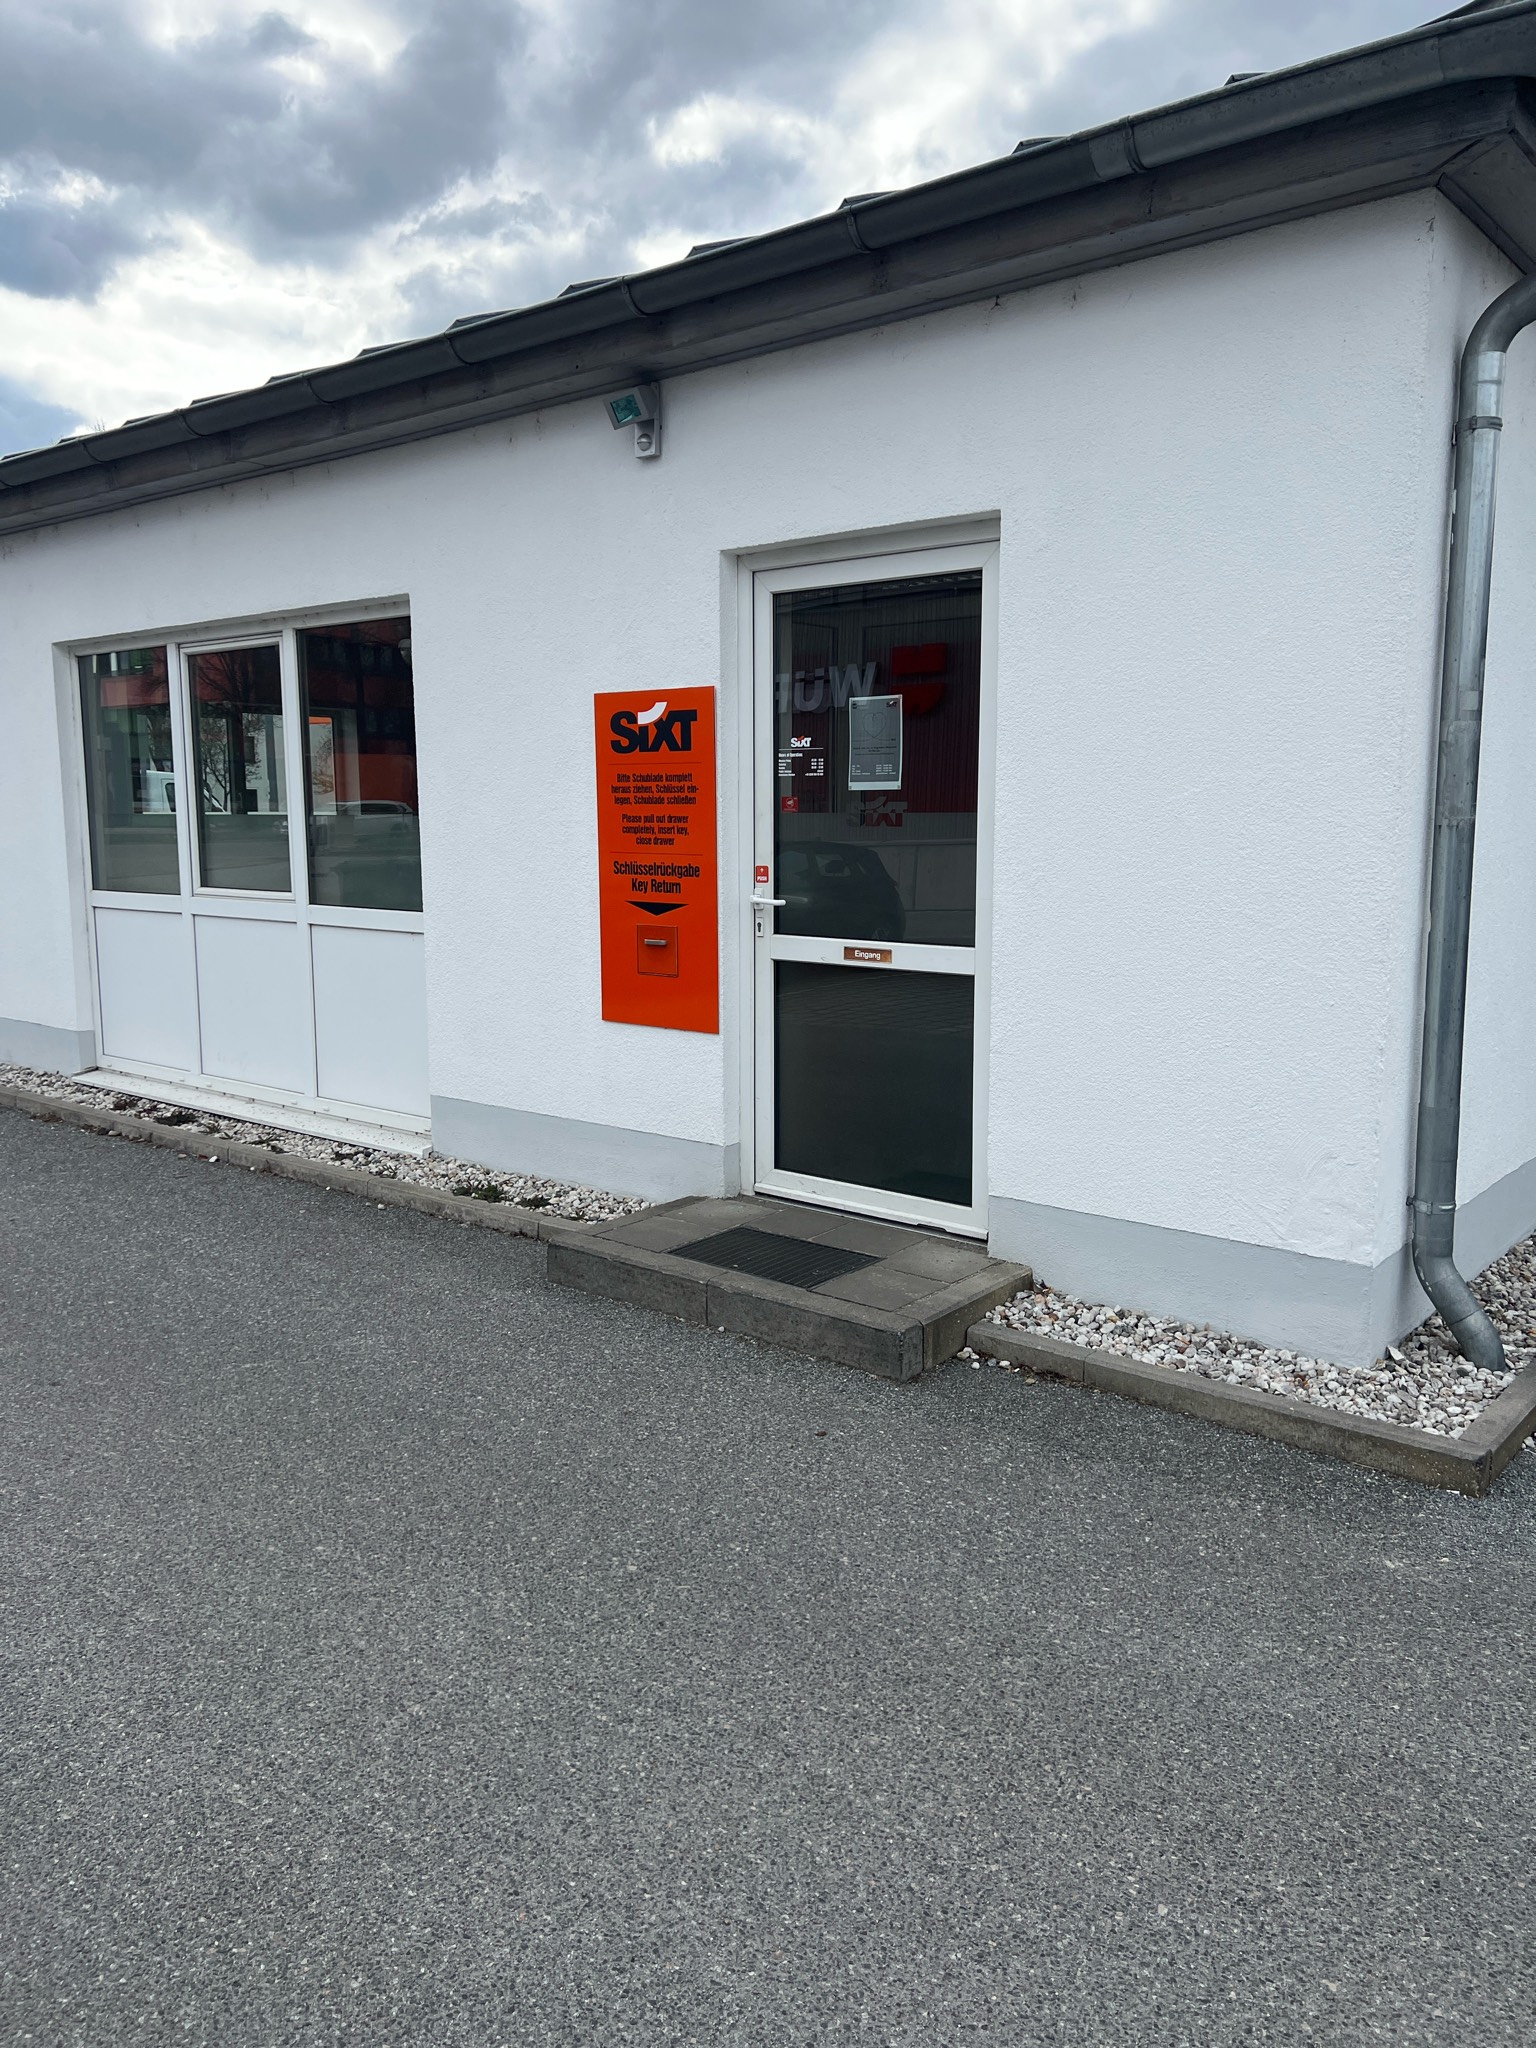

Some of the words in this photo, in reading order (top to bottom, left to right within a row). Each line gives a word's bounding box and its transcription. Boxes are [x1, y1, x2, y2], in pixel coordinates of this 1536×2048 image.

[617, 774, 630, 782] Bitte
[632, 773, 663, 782] Schublade
[665, 773, 692, 783] komplett
[611, 785, 631, 793] heraus
[633, 785, 654, 794] ziehen,
[656, 784, 685, 793] Schlüssel
[687, 785, 699, 793] ein-
[614, 796, 632, 805] legen,
[634, 796, 665, 804] Schublade
[667, 796, 696, 804] schließen
[622, 814, 641, 823] Please
[644, 814, 654, 824] pull
[656, 815, 665, 823] out
[667, 815, 689, 823] drawer
[622, 825, 656, 835] completely,
[658, 826, 675, 834] insert
[677, 826, 689, 836] key,
[636, 836, 652, 845] close
[653, 837, 675, 845] drawer
[613, 861, 700, 878] Schlüsselrückgabe
[632, 878, 648, 894] Key
[651, 879, 681, 893] Return
[855, 950, 880, 960] Eingang
